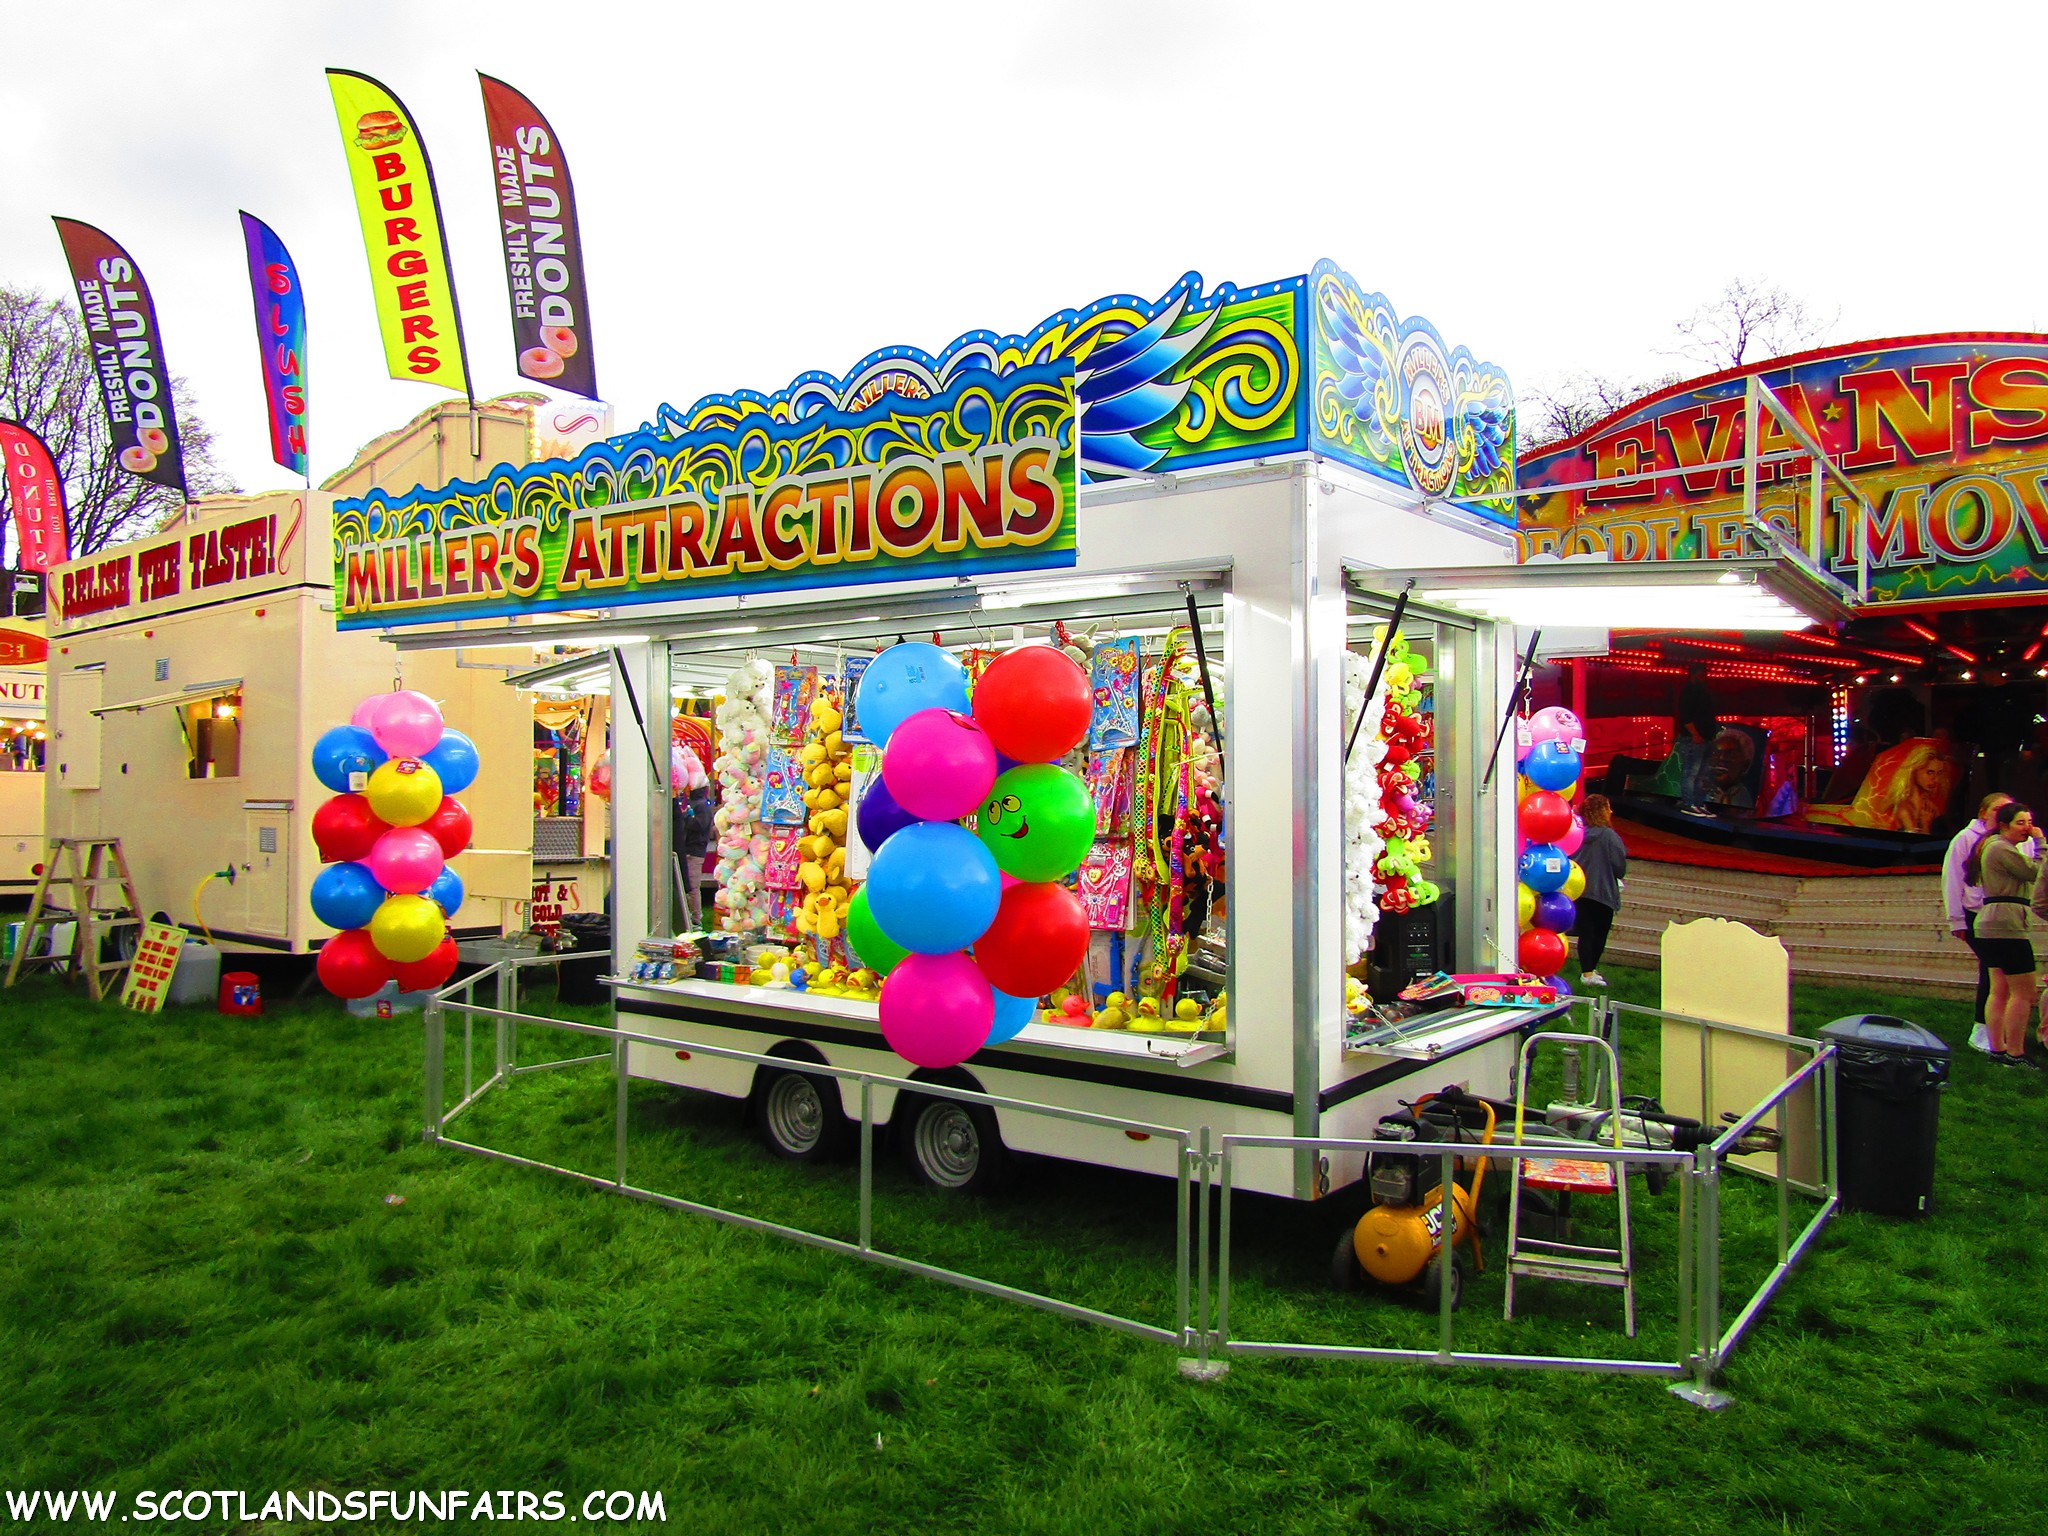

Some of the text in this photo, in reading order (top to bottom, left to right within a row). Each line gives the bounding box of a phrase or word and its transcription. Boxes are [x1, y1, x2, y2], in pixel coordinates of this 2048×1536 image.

[372, 152, 441, 375] BURGERS
[496, 145, 536, 319] FRESHLY MADE
[516, 125, 575, 327] DONUTS
[79, 279, 133, 424] FRESHLY MADE
[99, 257, 165, 429] DONUTS
[266, 263, 307, 455] SLUSH
[1414, 394, 1444, 445] BM
[341, 437, 1063, 614] MILLER'S ATTRACTIONS
[1400, 418, 1456, 491] ATTRACTIONS
[62, 514, 276, 621] RELISH THE TASTE!
[532, 885, 550, 902] OT
[532, 904, 562, 922] COLD
